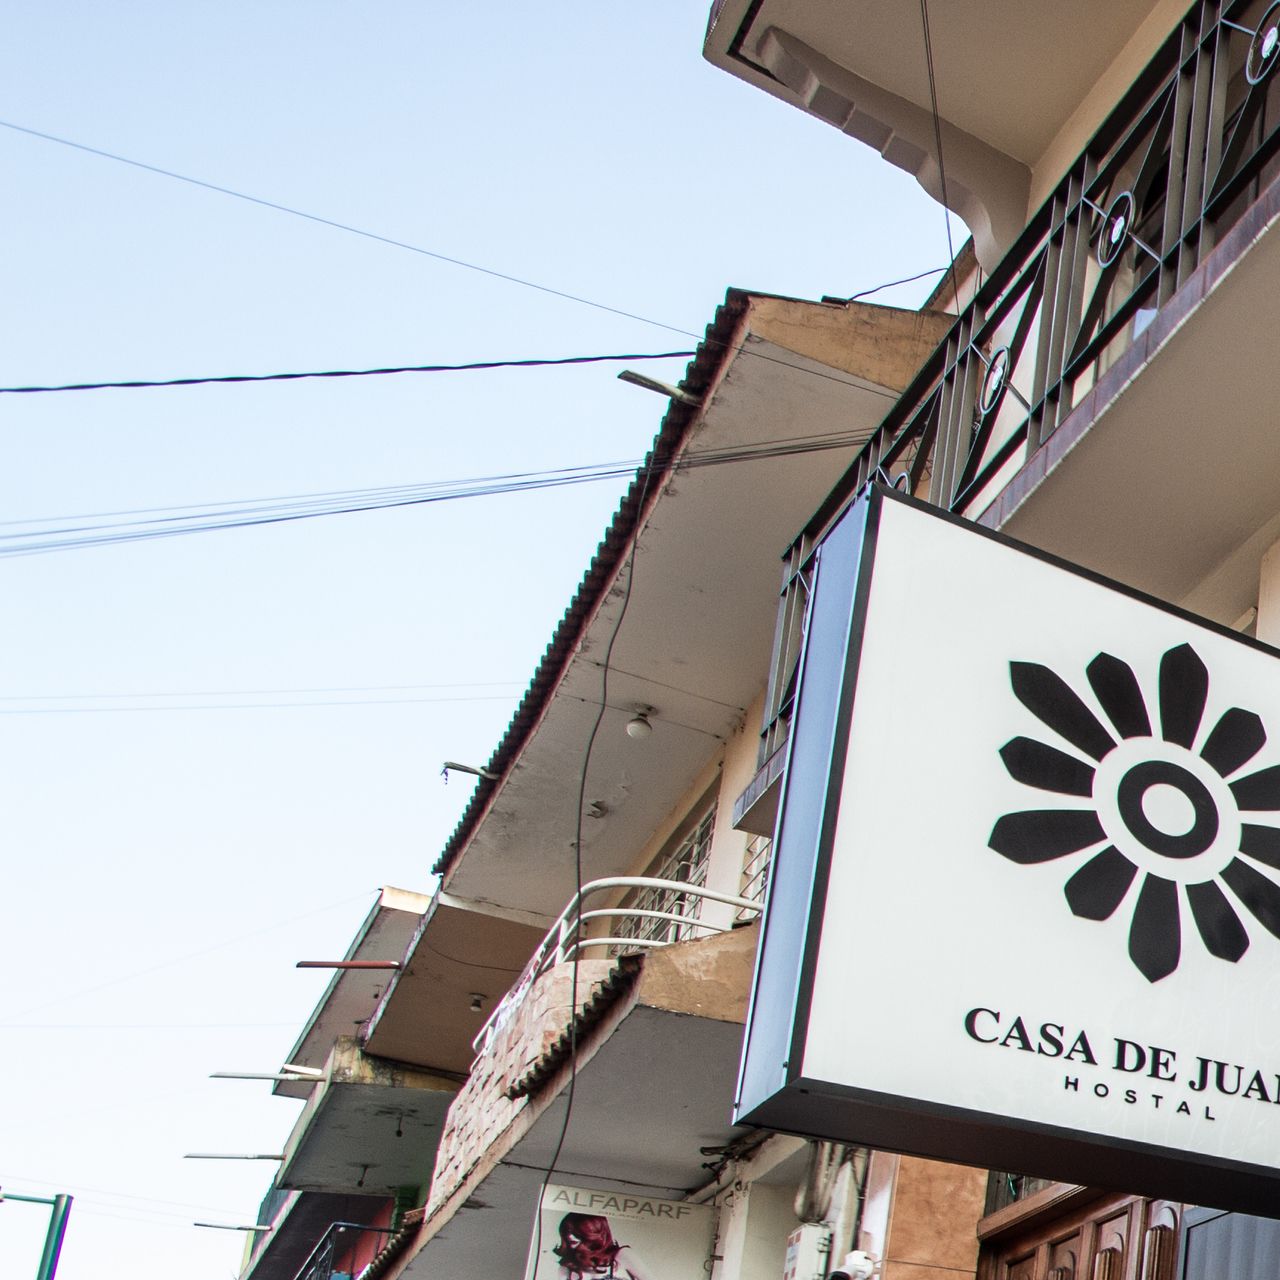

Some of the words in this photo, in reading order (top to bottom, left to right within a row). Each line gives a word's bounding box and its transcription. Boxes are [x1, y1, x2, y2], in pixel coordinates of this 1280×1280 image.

[964, 1007, 1099, 1066] CASA
[1112, 1037, 1178, 1083] DE
[1064, 1075, 1217, 1121] HOSTAL
[552, 1189, 693, 1220] ALFAPARF
